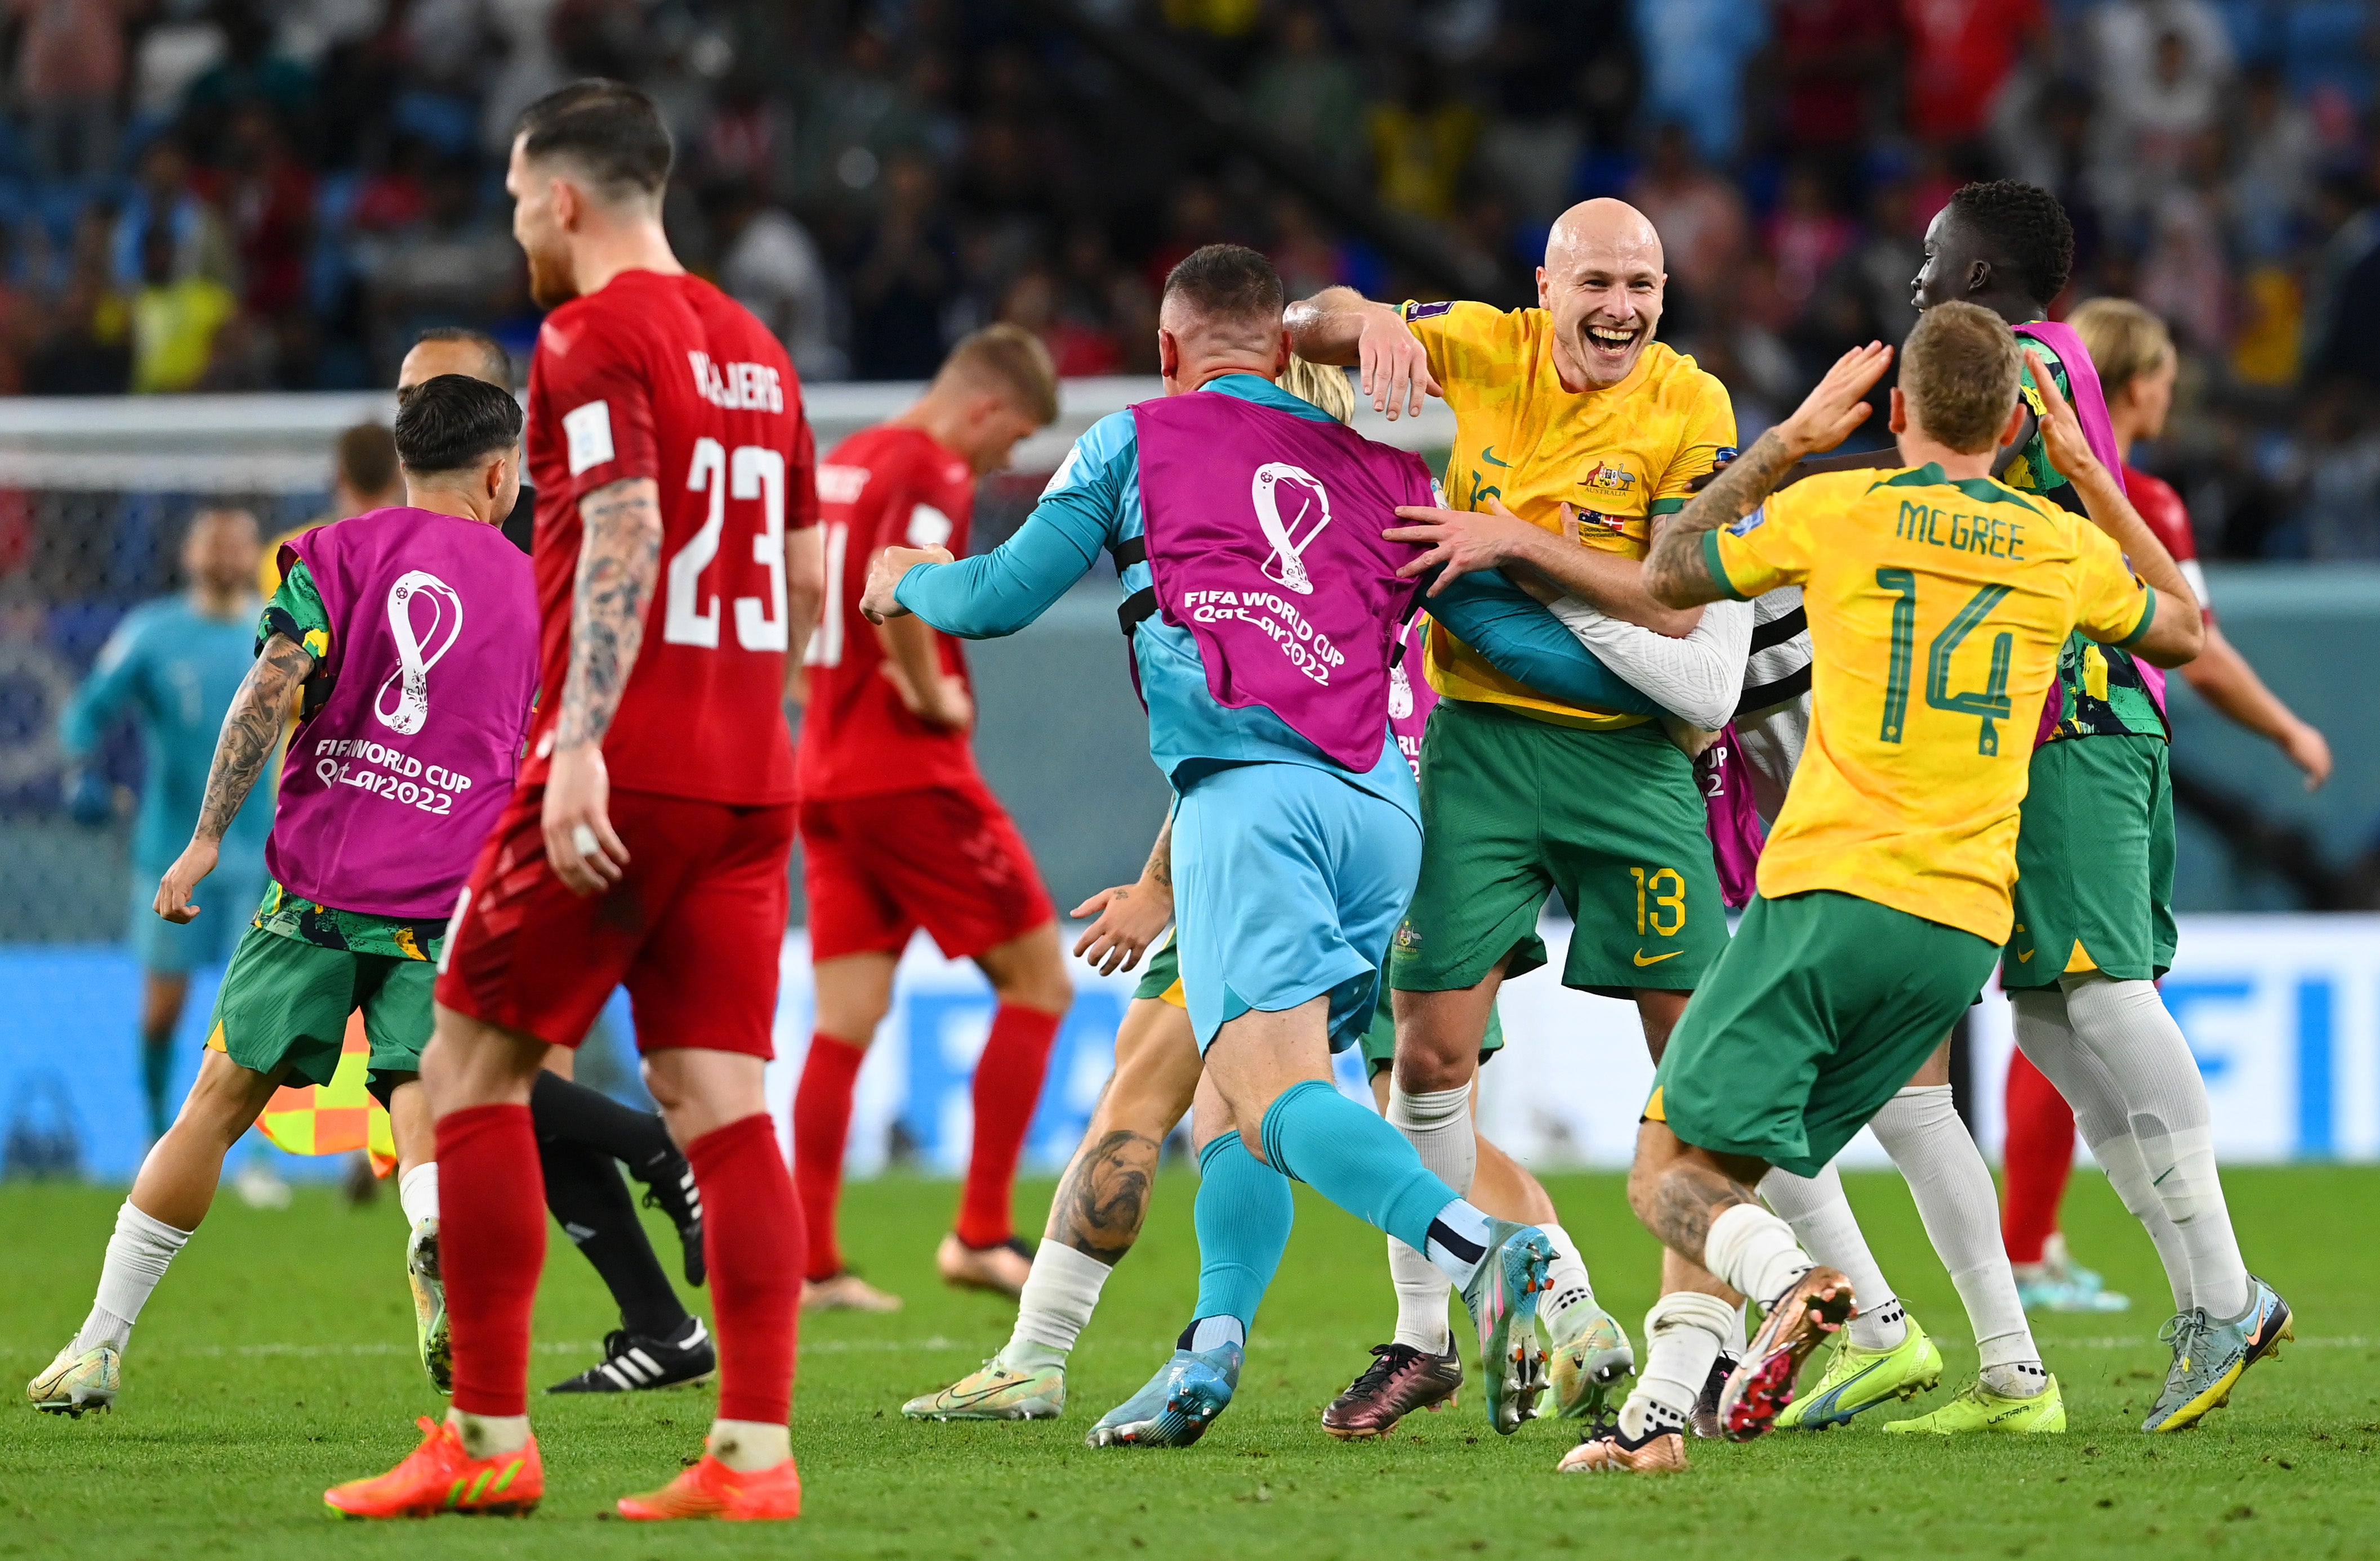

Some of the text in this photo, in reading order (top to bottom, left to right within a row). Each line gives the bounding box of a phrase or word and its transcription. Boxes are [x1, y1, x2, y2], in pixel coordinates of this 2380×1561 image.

[1584, 486, 1626, 497] AUSTRALIA
[663, 436, 789, 652] 23
[1896, 500, 2025, 561] MCGREE
[1184, 590, 1345, 668] FIFA WORLD CUP
[1876, 568, 2014, 757] 14
[315, 739, 472, 793] FIFA WORLD CUP
[1630, 867, 1685, 936] 13
[1987, 1405, 2030, 1424] ULTRA
